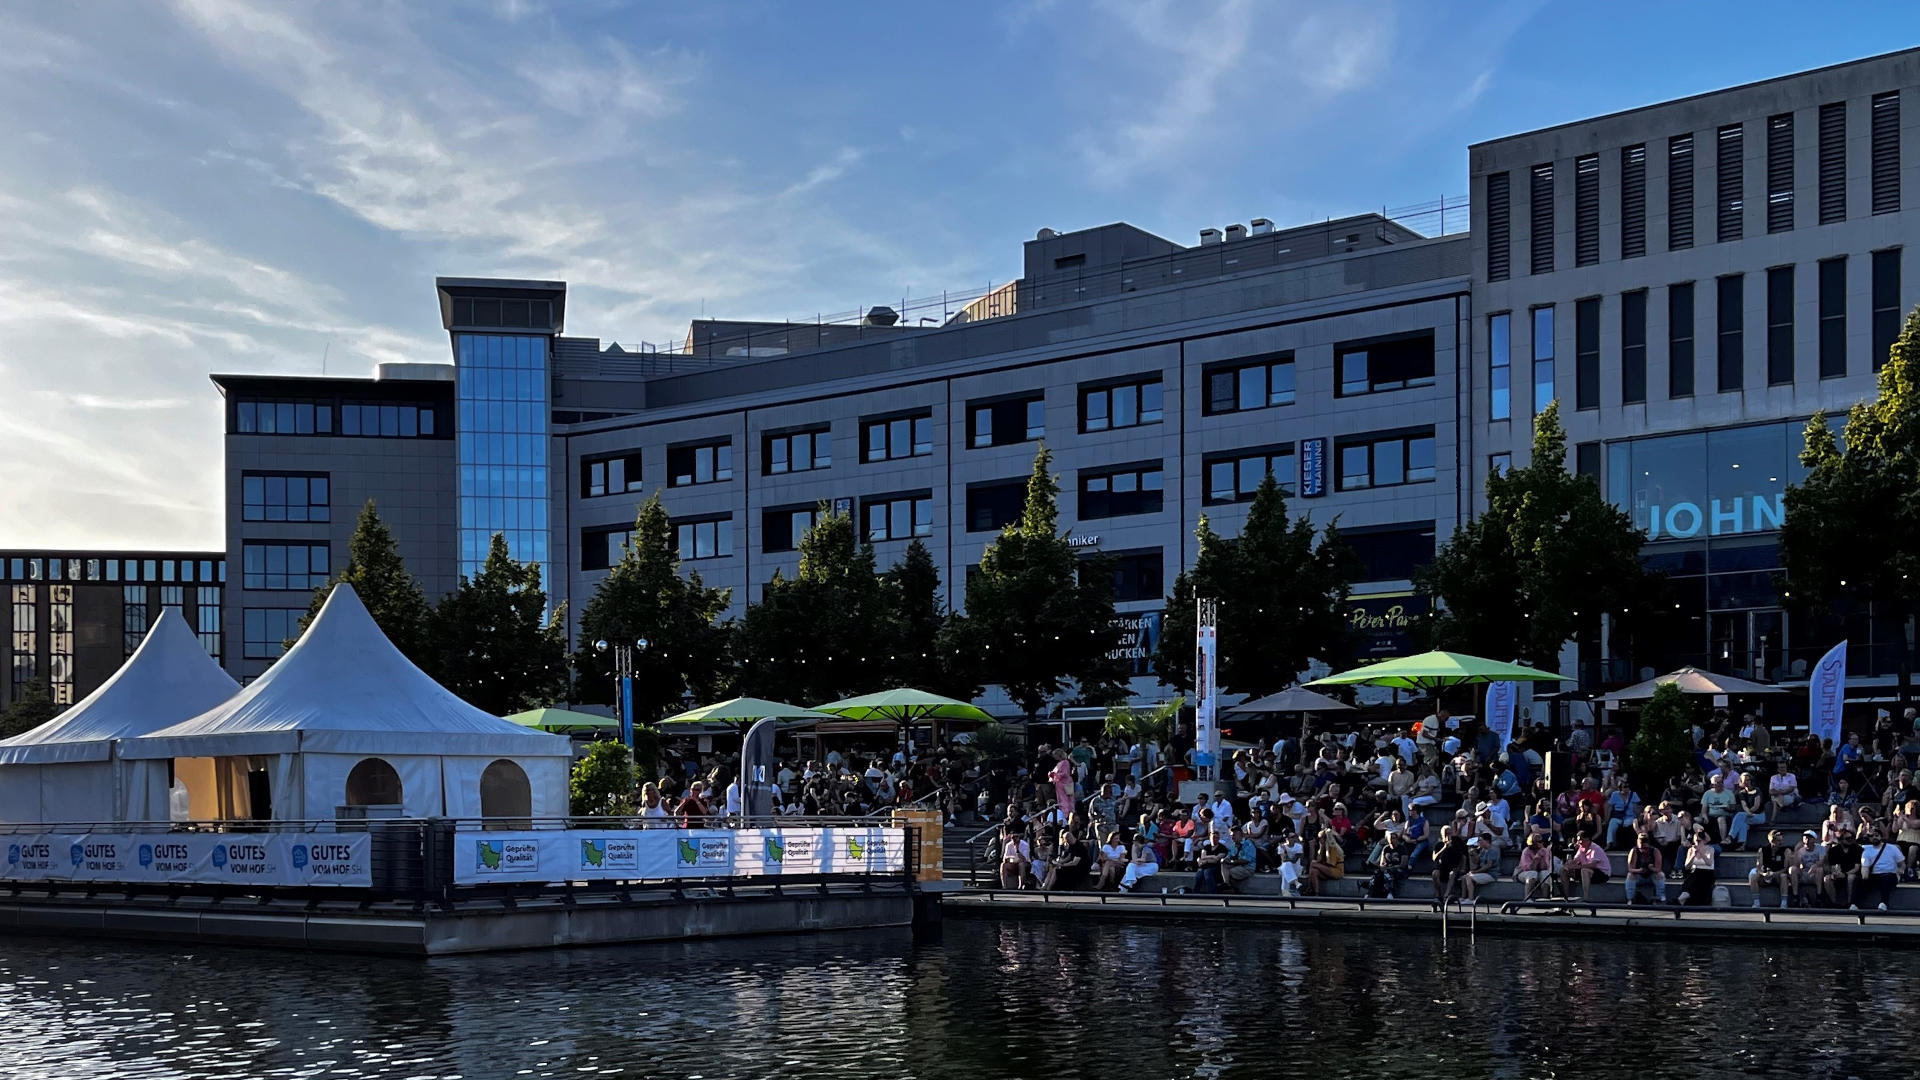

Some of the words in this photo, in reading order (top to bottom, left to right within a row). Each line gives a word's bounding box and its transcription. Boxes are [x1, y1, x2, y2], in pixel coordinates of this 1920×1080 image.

[1303, 440, 1312, 496] KIESER
[1314, 439, 1322, 493] TRAINING
[1646, 493, 1785, 542] JOHN
[1350, 607, 1385, 629] Peter
[22, 844, 50, 858] GUTES
[85, 844, 116, 858] GUTES
[154, 844, 188, 859] GUTES
[229, 845, 266, 860] GUTES
[311, 845, 351, 861] GUTES
[607, 843, 635, 851] Geprüfte
[505, 853, 533, 863] Qualität
[607, 852, 633, 860] Qualität
[22, 861, 36, 869] VOM
[86, 861, 101, 870] VOM
[155, 862, 172, 871] VOM
[230, 863, 248, 873] VOM
[312, 864, 331, 874] VOM
